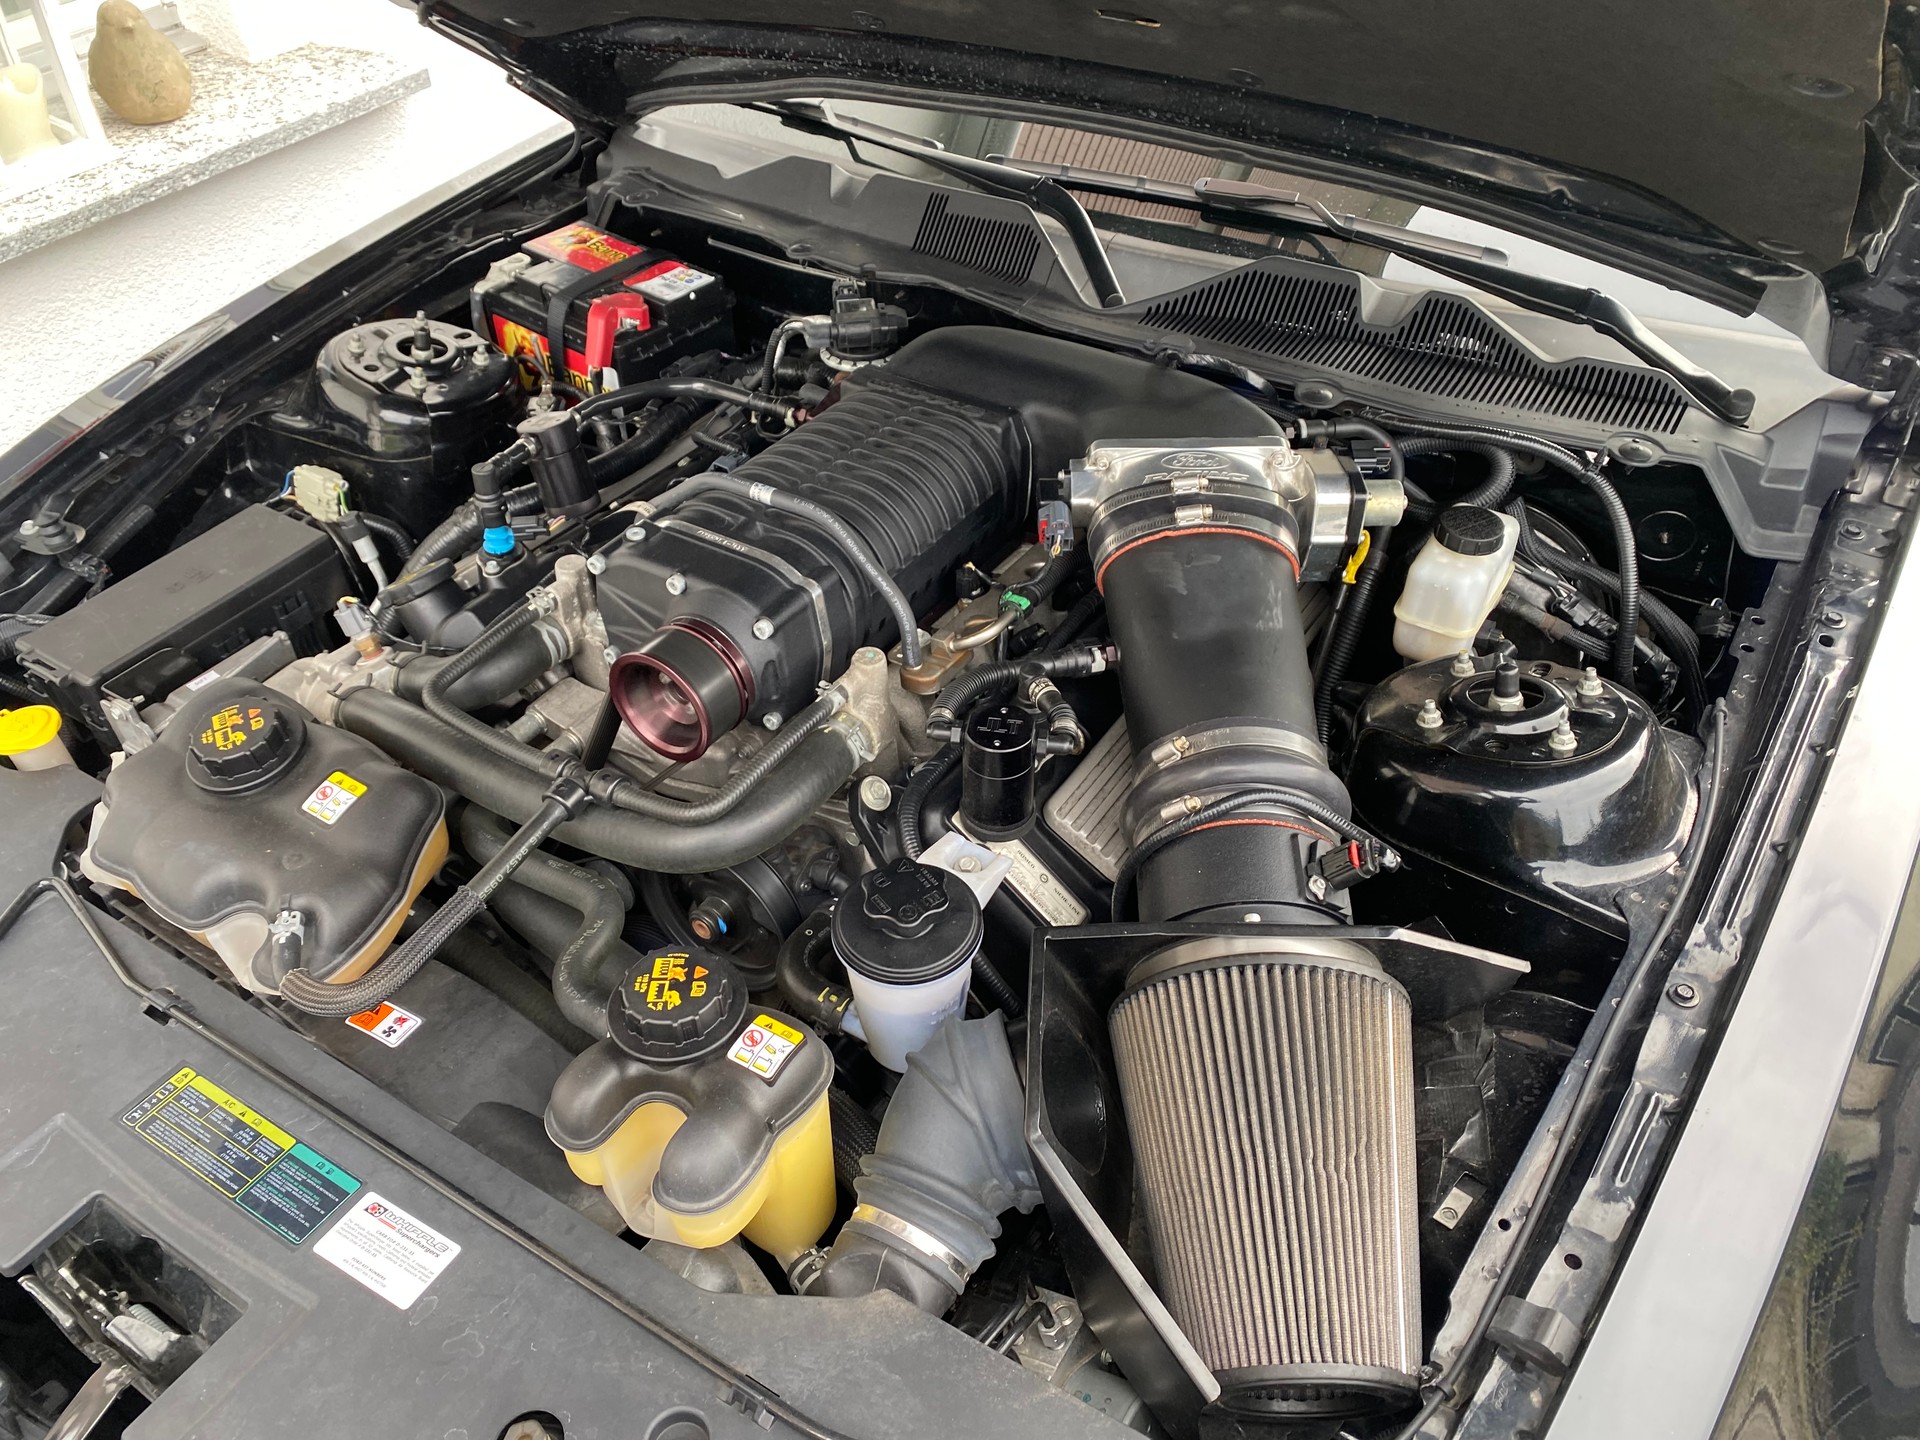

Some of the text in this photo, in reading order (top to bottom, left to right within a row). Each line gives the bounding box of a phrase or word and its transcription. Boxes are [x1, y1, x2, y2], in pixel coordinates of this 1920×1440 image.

[1172, 453, 1221, 467] Ford
[977, 717, 1024, 735] JLT
[221, 1098, 236, 1109] A/C
[383, 1209, 450, 1254] WHIPPLE
[394, 1227, 441, 1259] Superchargers
